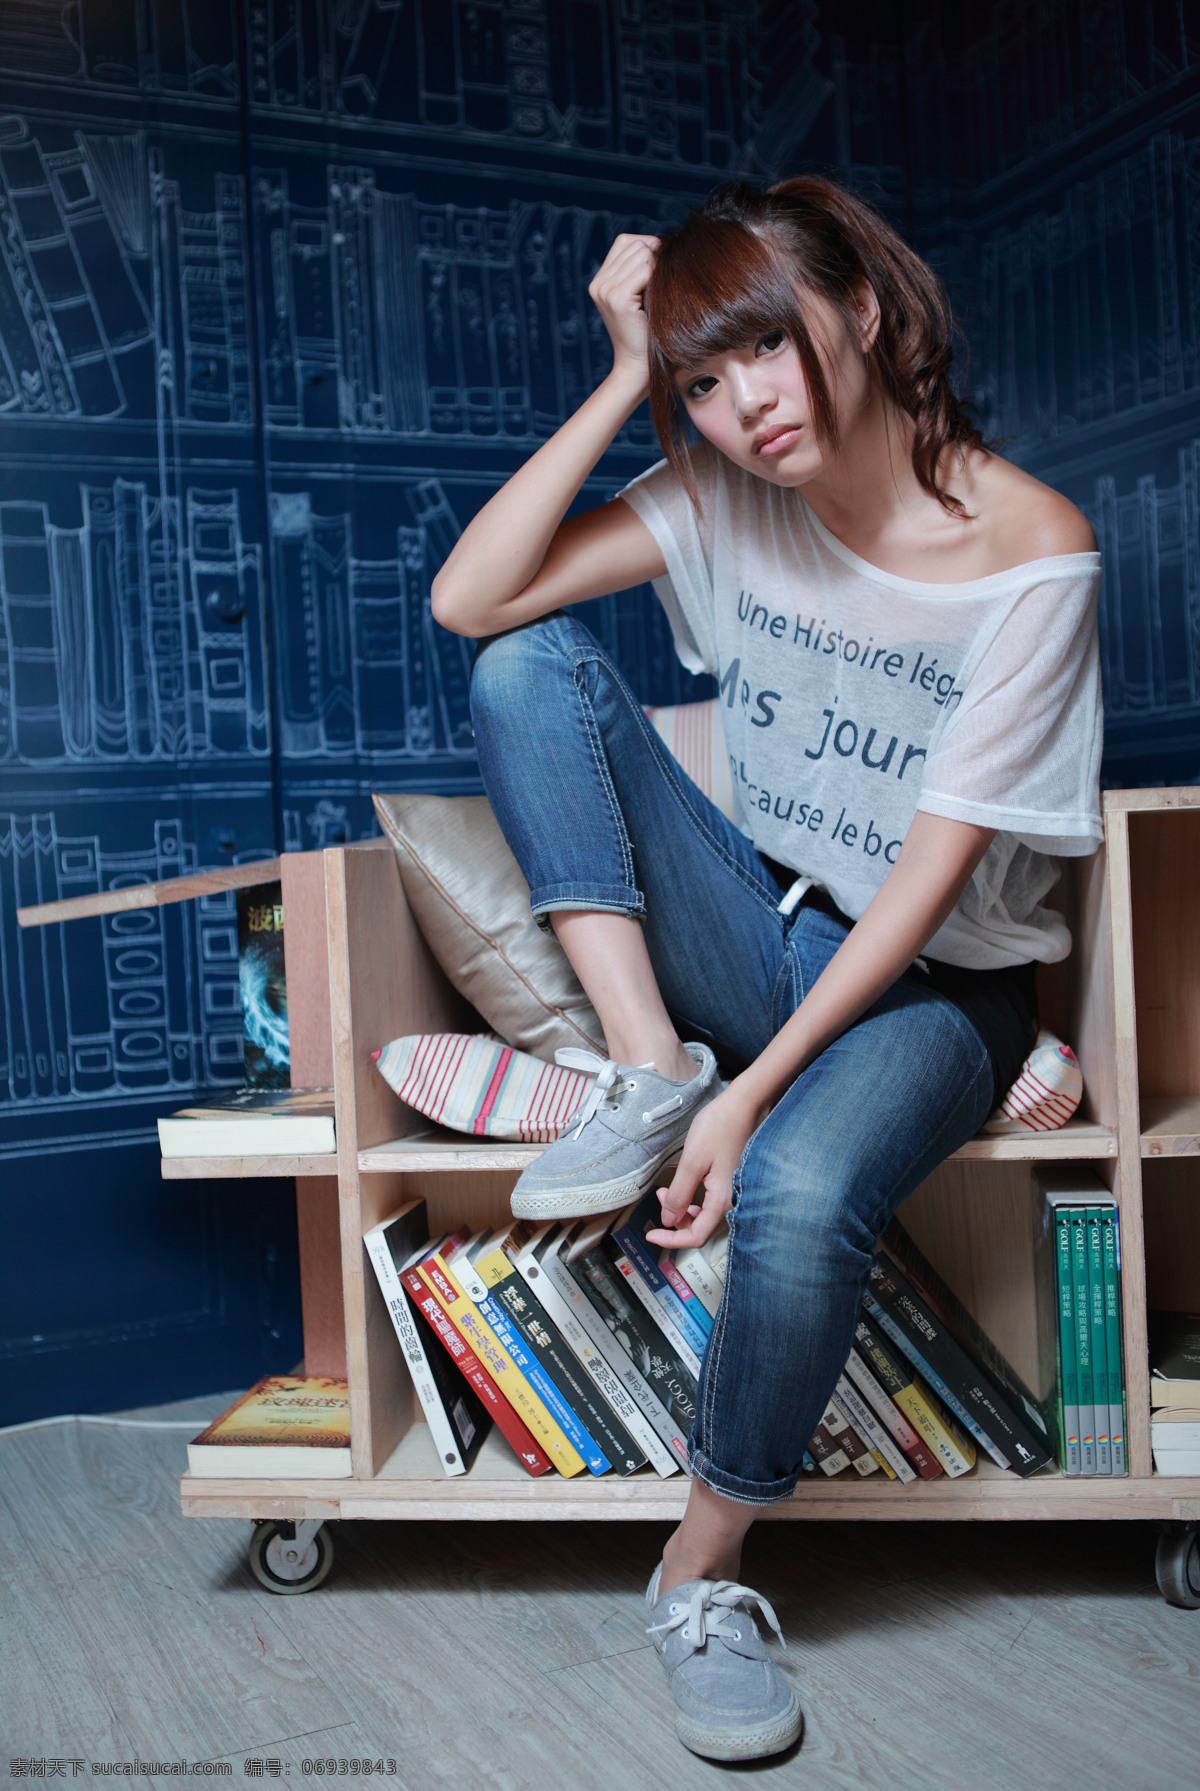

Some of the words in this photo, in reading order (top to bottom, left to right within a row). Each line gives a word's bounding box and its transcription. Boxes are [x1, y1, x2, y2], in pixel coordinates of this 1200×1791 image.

[738, 590, 786, 638] Une
[793, 614, 903, 678] Histoire
[831, 807, 858, 847] le
[1060, 1228, 1069, 1252] GOLF
[1076, 1228, 1084, 1252] GOLF
[1092, 1228, 1100, 1251] GOLF
[1106, 1228, 1114, 1252] GOLF
[430, 1268, 452, 1296] EMBA
[1062, 1285, 1072, 1317] 短桿策略
[1093, 1284, 1102, 1324] 全揮桿策略
[1106, 1285, 1116, 1316] 推桿策略
[389, 1297, 423, 1364] 時間的齒輪
[420, 1295, 467, 1358] 現代驅魔師
[477, 1299, 529, 1368] 創意無限公司
[502, 1283, 552, 1349] 浮華一世情
[896, 1293, 938, 1341] 完美的間諜
[1077, 1284, 1089, 1366] 球場攻略與高爾夫心理
[459, 1311, 508, 1375] 紫牛學管理
[587, 1355, 635, 1419] 時間的齒輪
[623, 1368, 660, 1418] 下一代企業
